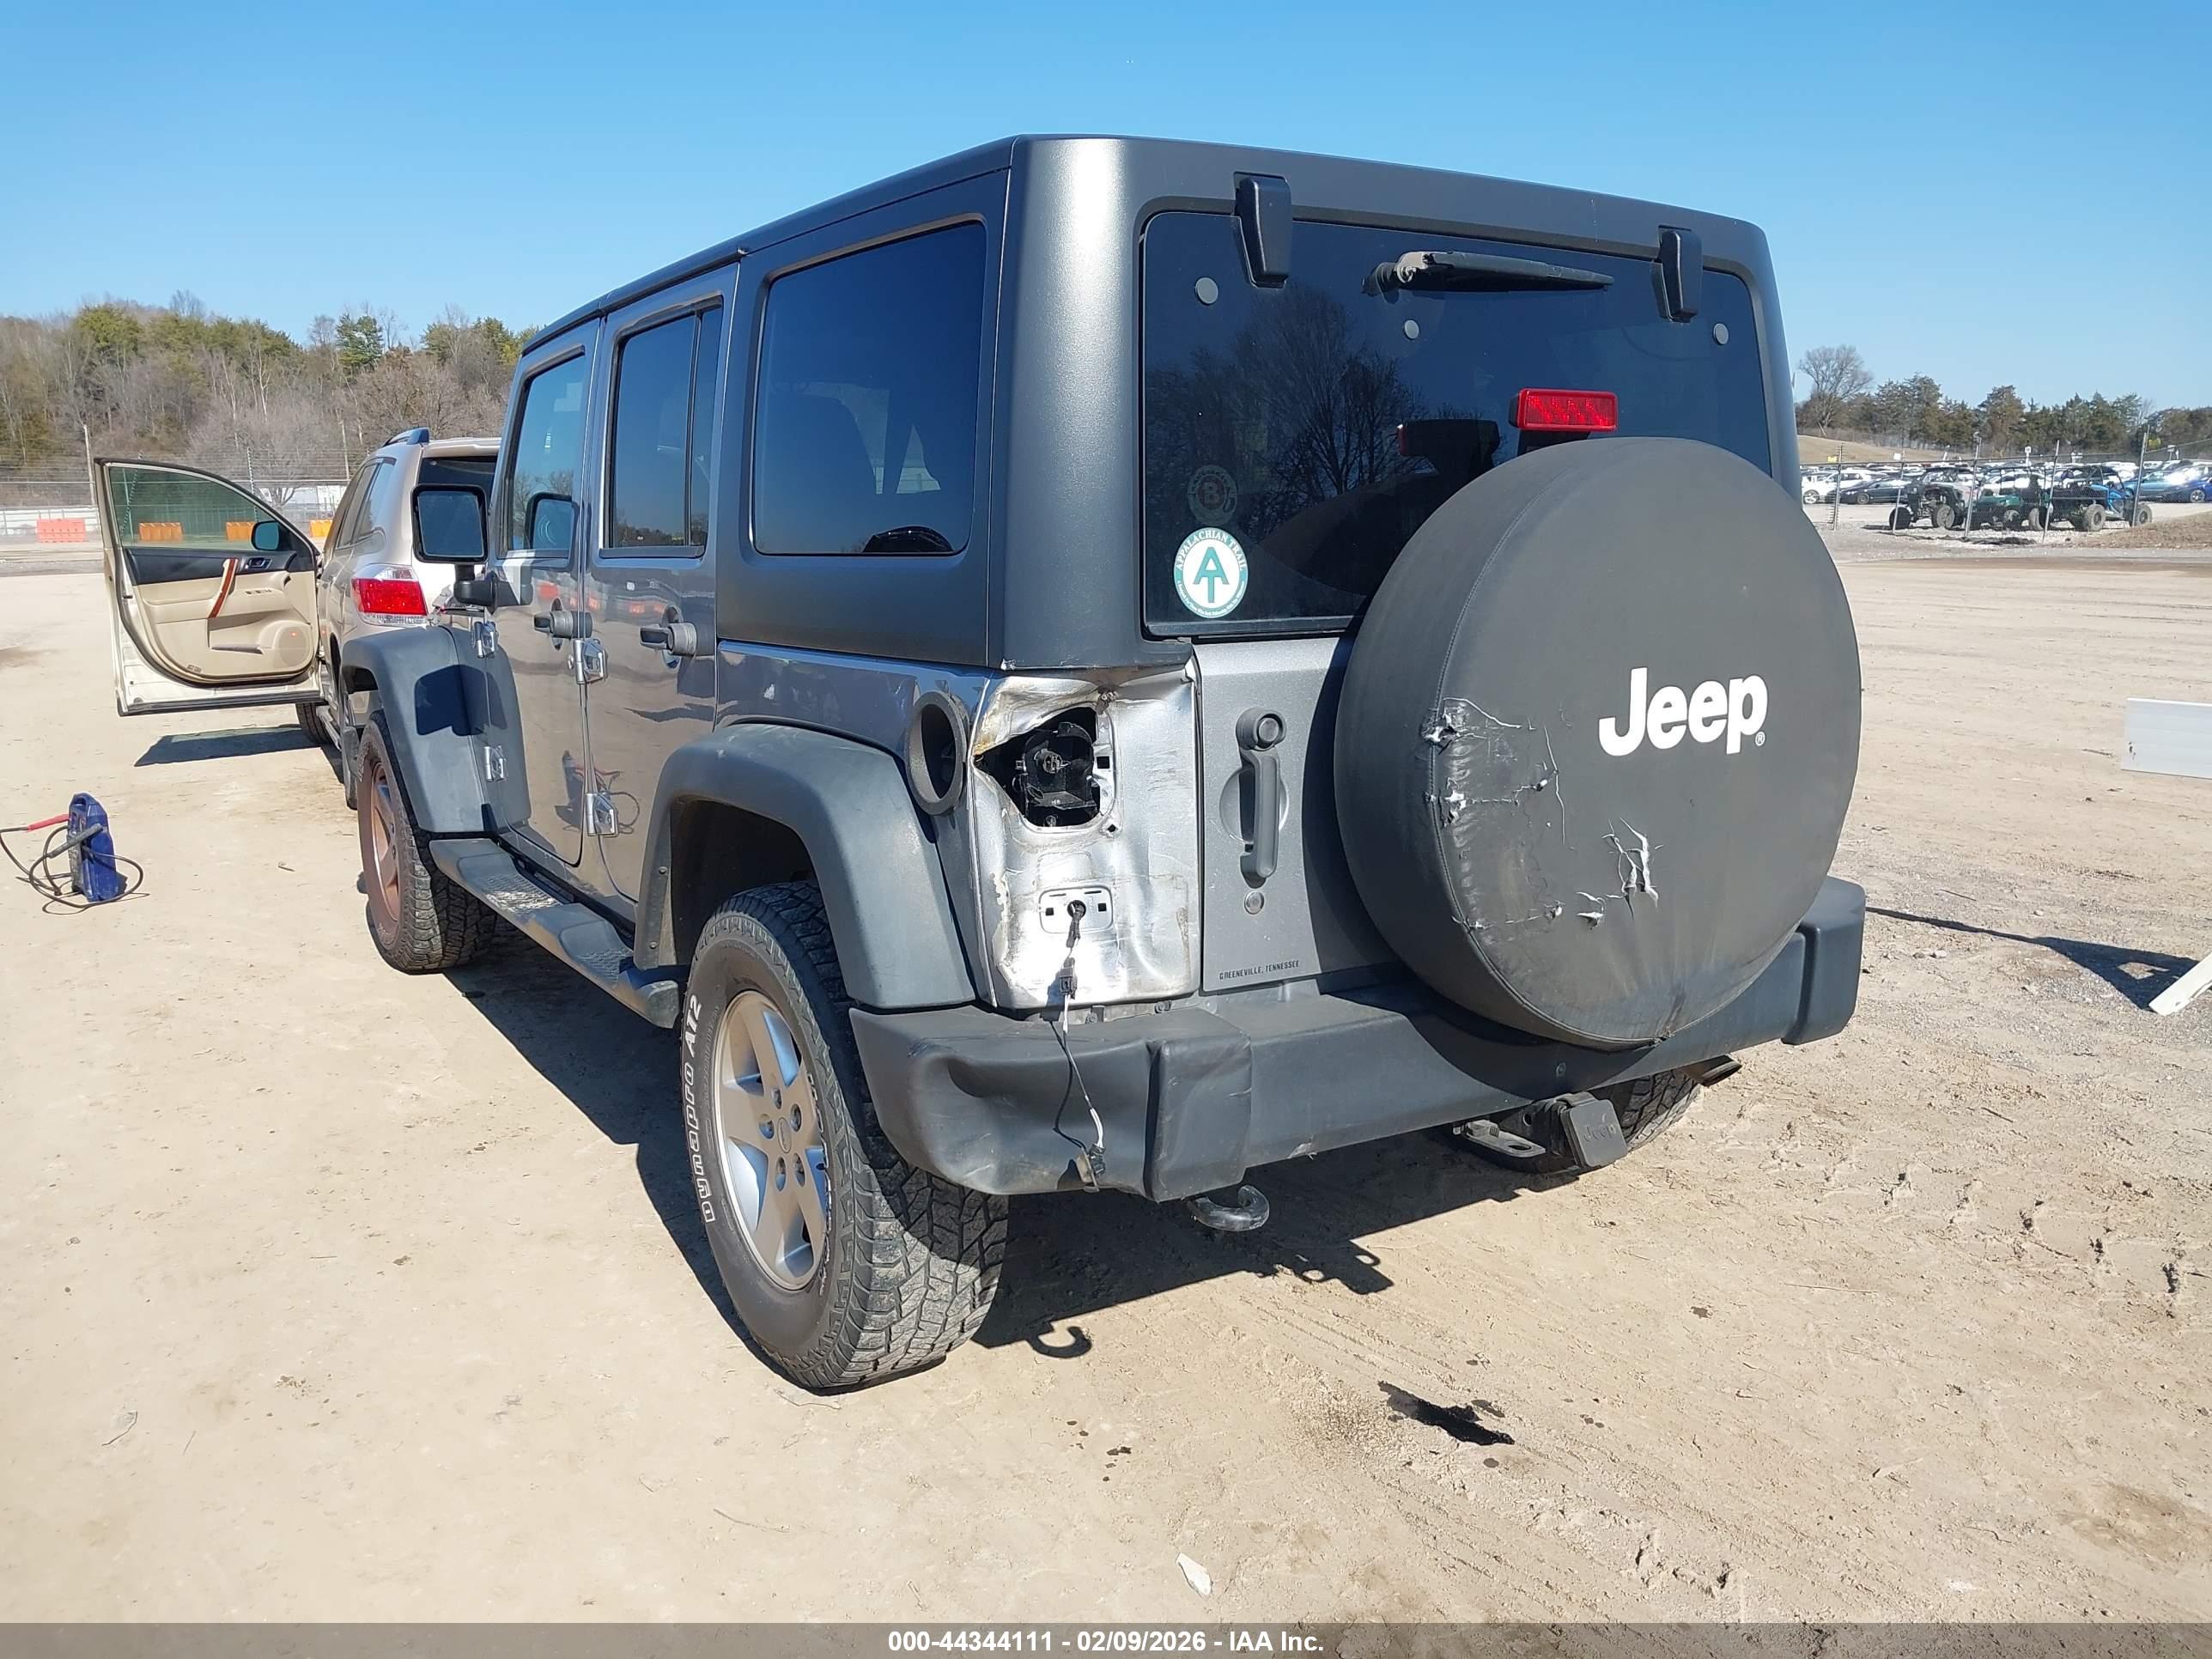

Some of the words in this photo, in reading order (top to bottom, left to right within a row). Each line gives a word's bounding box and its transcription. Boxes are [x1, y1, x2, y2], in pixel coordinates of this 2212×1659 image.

[1176, 529, 1229, 570] APPALACHIAN
[1228, 538, 1246, 571] TRAIL
[1598, 666, 1768, 757] Jeep
[1265, 960, 1299, 973] TENNESSEE
[684, 994, 702, 1058] AT2
